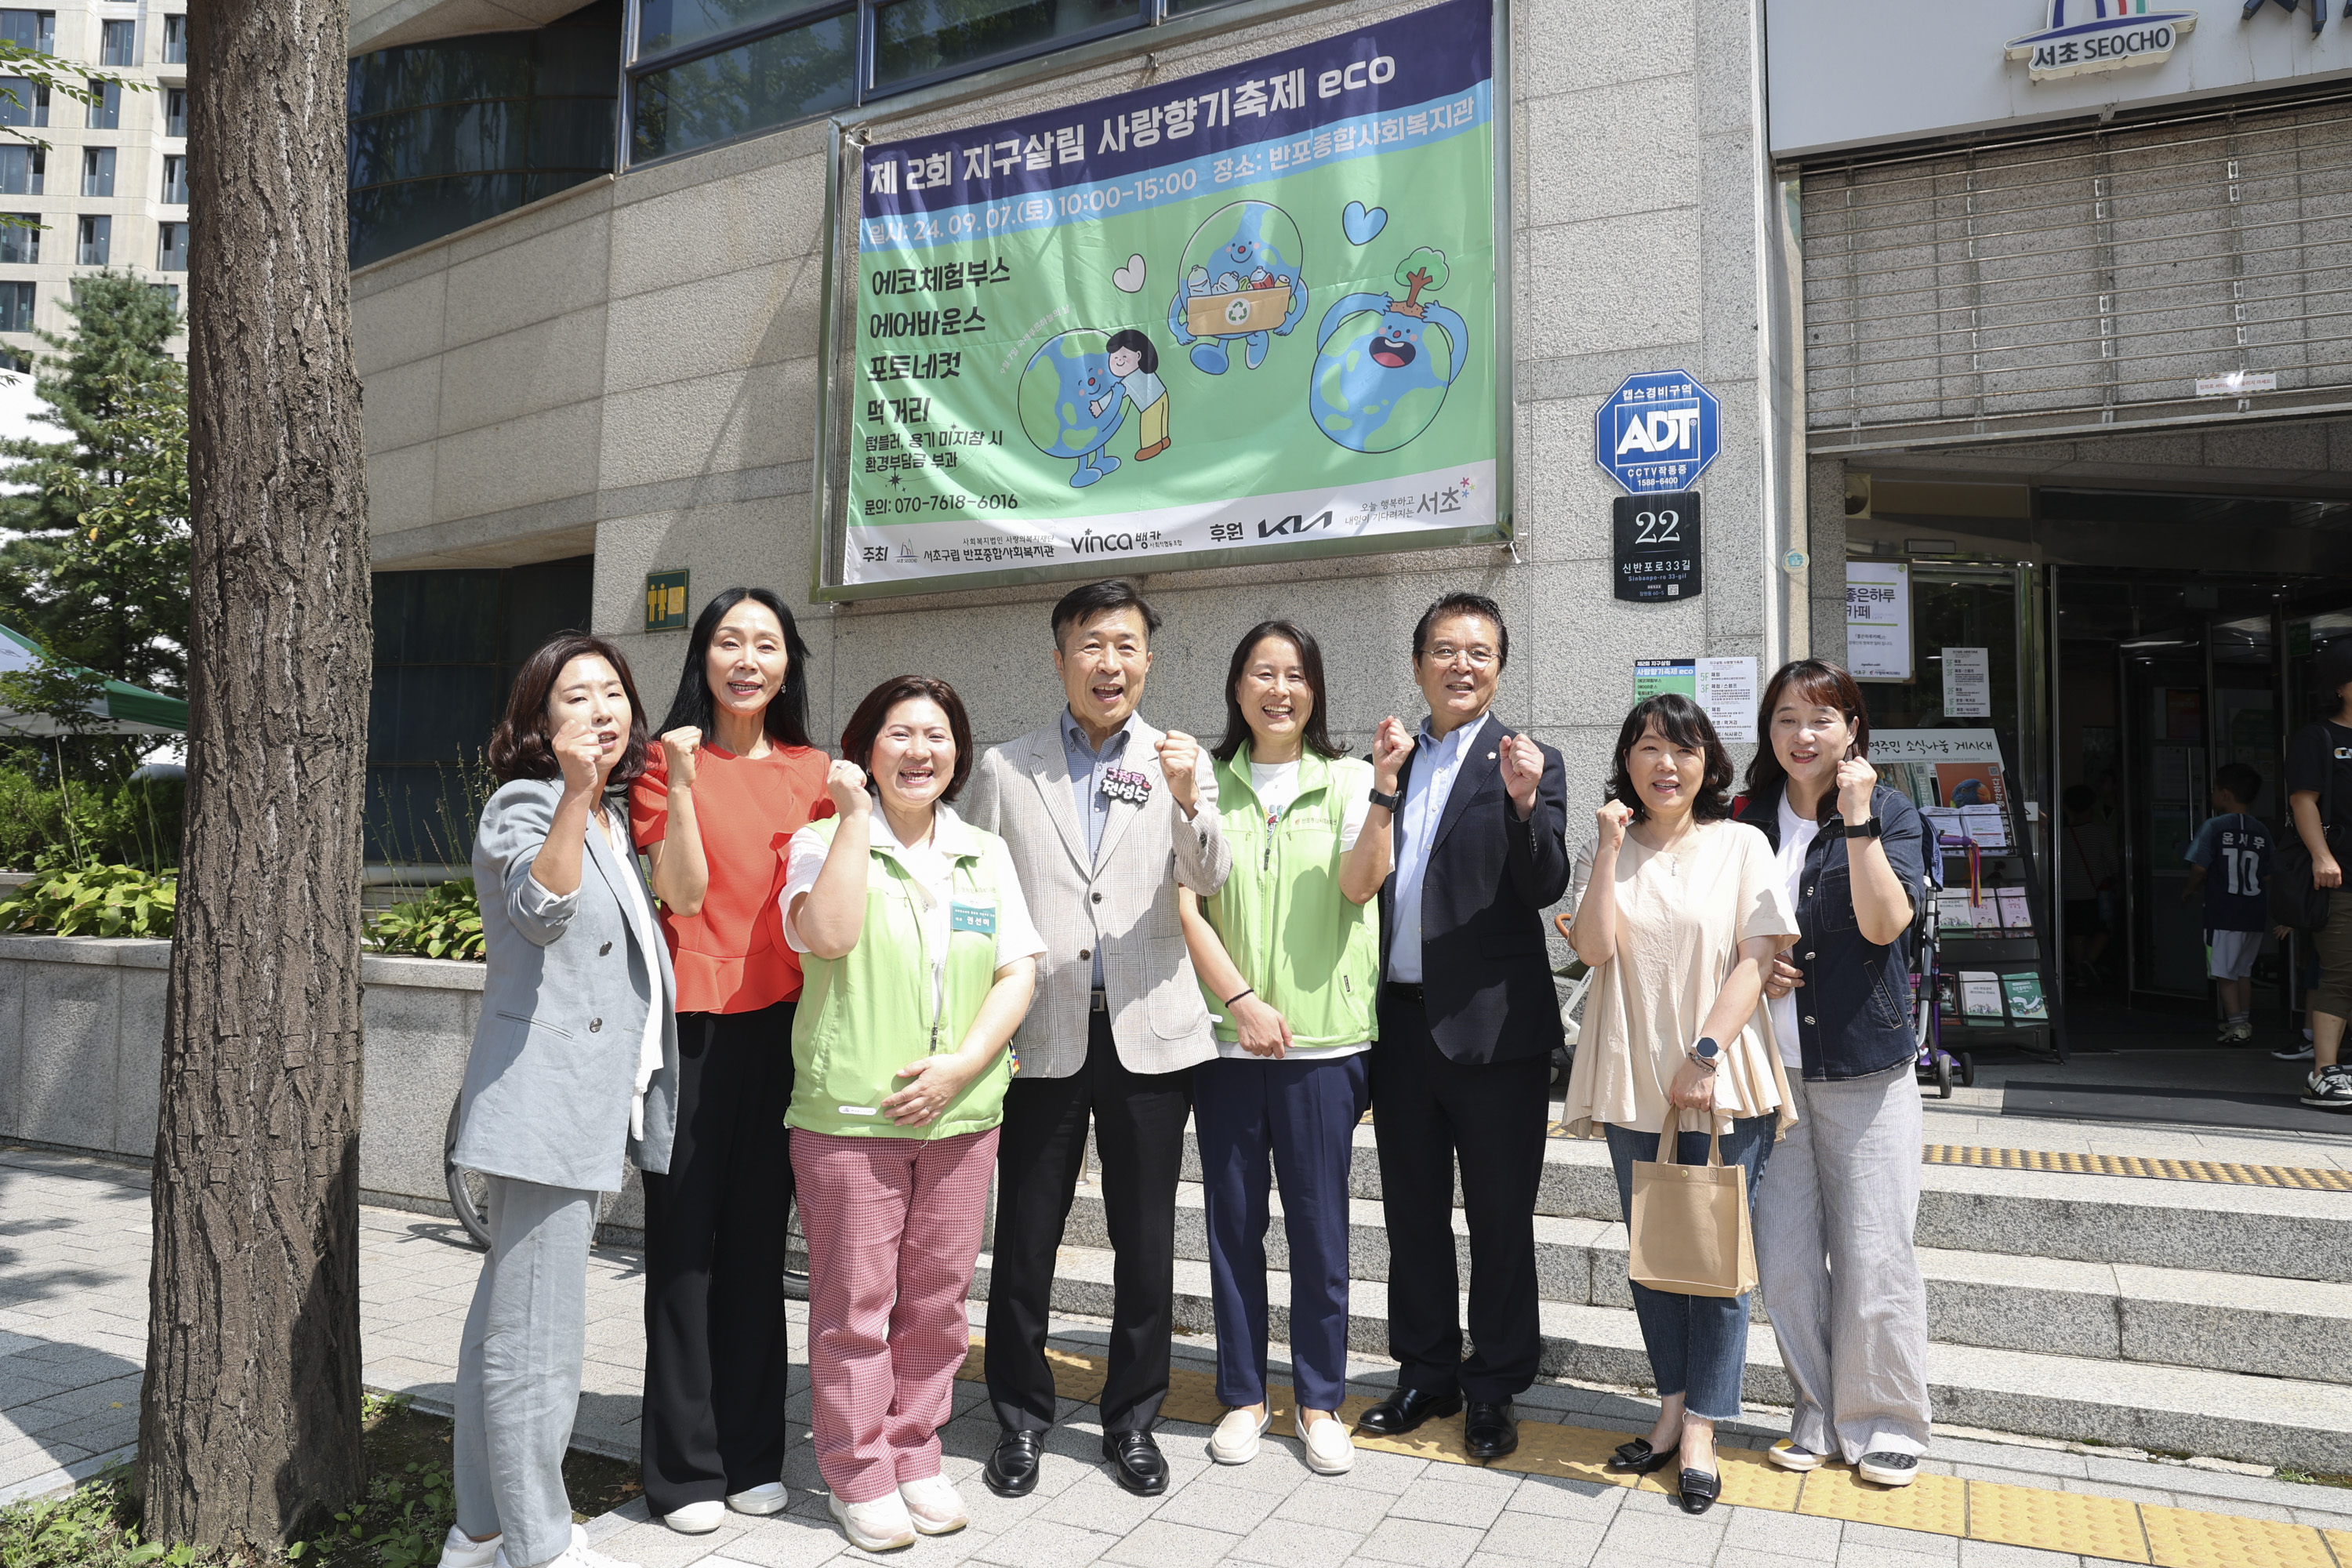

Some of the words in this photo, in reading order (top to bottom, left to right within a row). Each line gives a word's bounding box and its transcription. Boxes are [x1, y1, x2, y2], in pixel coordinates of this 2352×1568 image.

[2034, 42, 2079, 67] 서초
[2083, 27, 2171, 60] SEOCHO
[869, 159, 898, 195] 제
[906, 151, 952, 191] 2회
[963, 122, 1085, 181] 지구살림
[1097, 67, 1307, 155] 사랑향기축제
[1317, 55, 1396, 100] eco
[913, 219, 944, 241] 24.
[948, 214, 982, 235] 09.
[1058, 167, 1197, 216] 10:00-15:00
[1213, 152, 1262, 183] 장소:
[1269, 95, 1475, 172] 반포종합사회복지관
[869, 306, 986, 339] 에어바운스
[867, 351, 961, 382] 포토네컷
[1622, 383, 1693, 401] 캡스경비구역
[867, 397, 931, 426] 먹거리
[1616, 408, 1699, 455] ADT
[866, 433, 904, 452] 텀블러,
[909, 431, 935, 448] 용기
[938, 430, 985, 446] 미지참
[988, 430, 1003, 446] 시
[865, 452, 927, 474] 환경부담금
[930, 451, 958, 469] 부과
[1637, 477, 1679, 487] 1588-6400
[864, 498, 891, 516] 문의:
[895, 493, 1018, 514] 070-7618-6016
[1359, 502, 1378, 513] 오늘
[1381, 495, 1416, 510] 행복하고
[1416, 485, 1462, 515] 서초
[1345, 513, 1370, 526] 내일이
[1372, 508, 1415, 523] 기다려지는
[1210, 521, 1245, 543] 후원
[1635, 510, 1681, 545] 22
[962, 536, 1004, 546] 사회복지법인
[1070, 528, 1134, 554] vinca
[862, 546, 888, 563] 주최
[923, 549, 960, 563] 서초구립
[963, 545, 1055, 563] 반포종합사회복지관
[1622, 559, 1691, 575] 신반포로33길
[1668, 572, 1687, 581] 33-gil
[1846, 588, 1896, 603] 좋은하루
[1636, 667, 1678, 676] 사랑향기축제
[1700, 672, 1710, 682] 5F
[1700, 684, 1710, 694] 3F
[1869, 740, 1901, 755] 역주민
[1906, 739, 1950, 755] 소식나눔
[1954, 741, 1994, 751] 게시대
[1106, 768, 1145, 786] 구청장
[1102, 779, 1149, 802] 전성수
[2222, 848, 2262, 897] 10
[967, 916, 990, 927] 권선미
[1581, 974, 1592, 989] CAMPER
